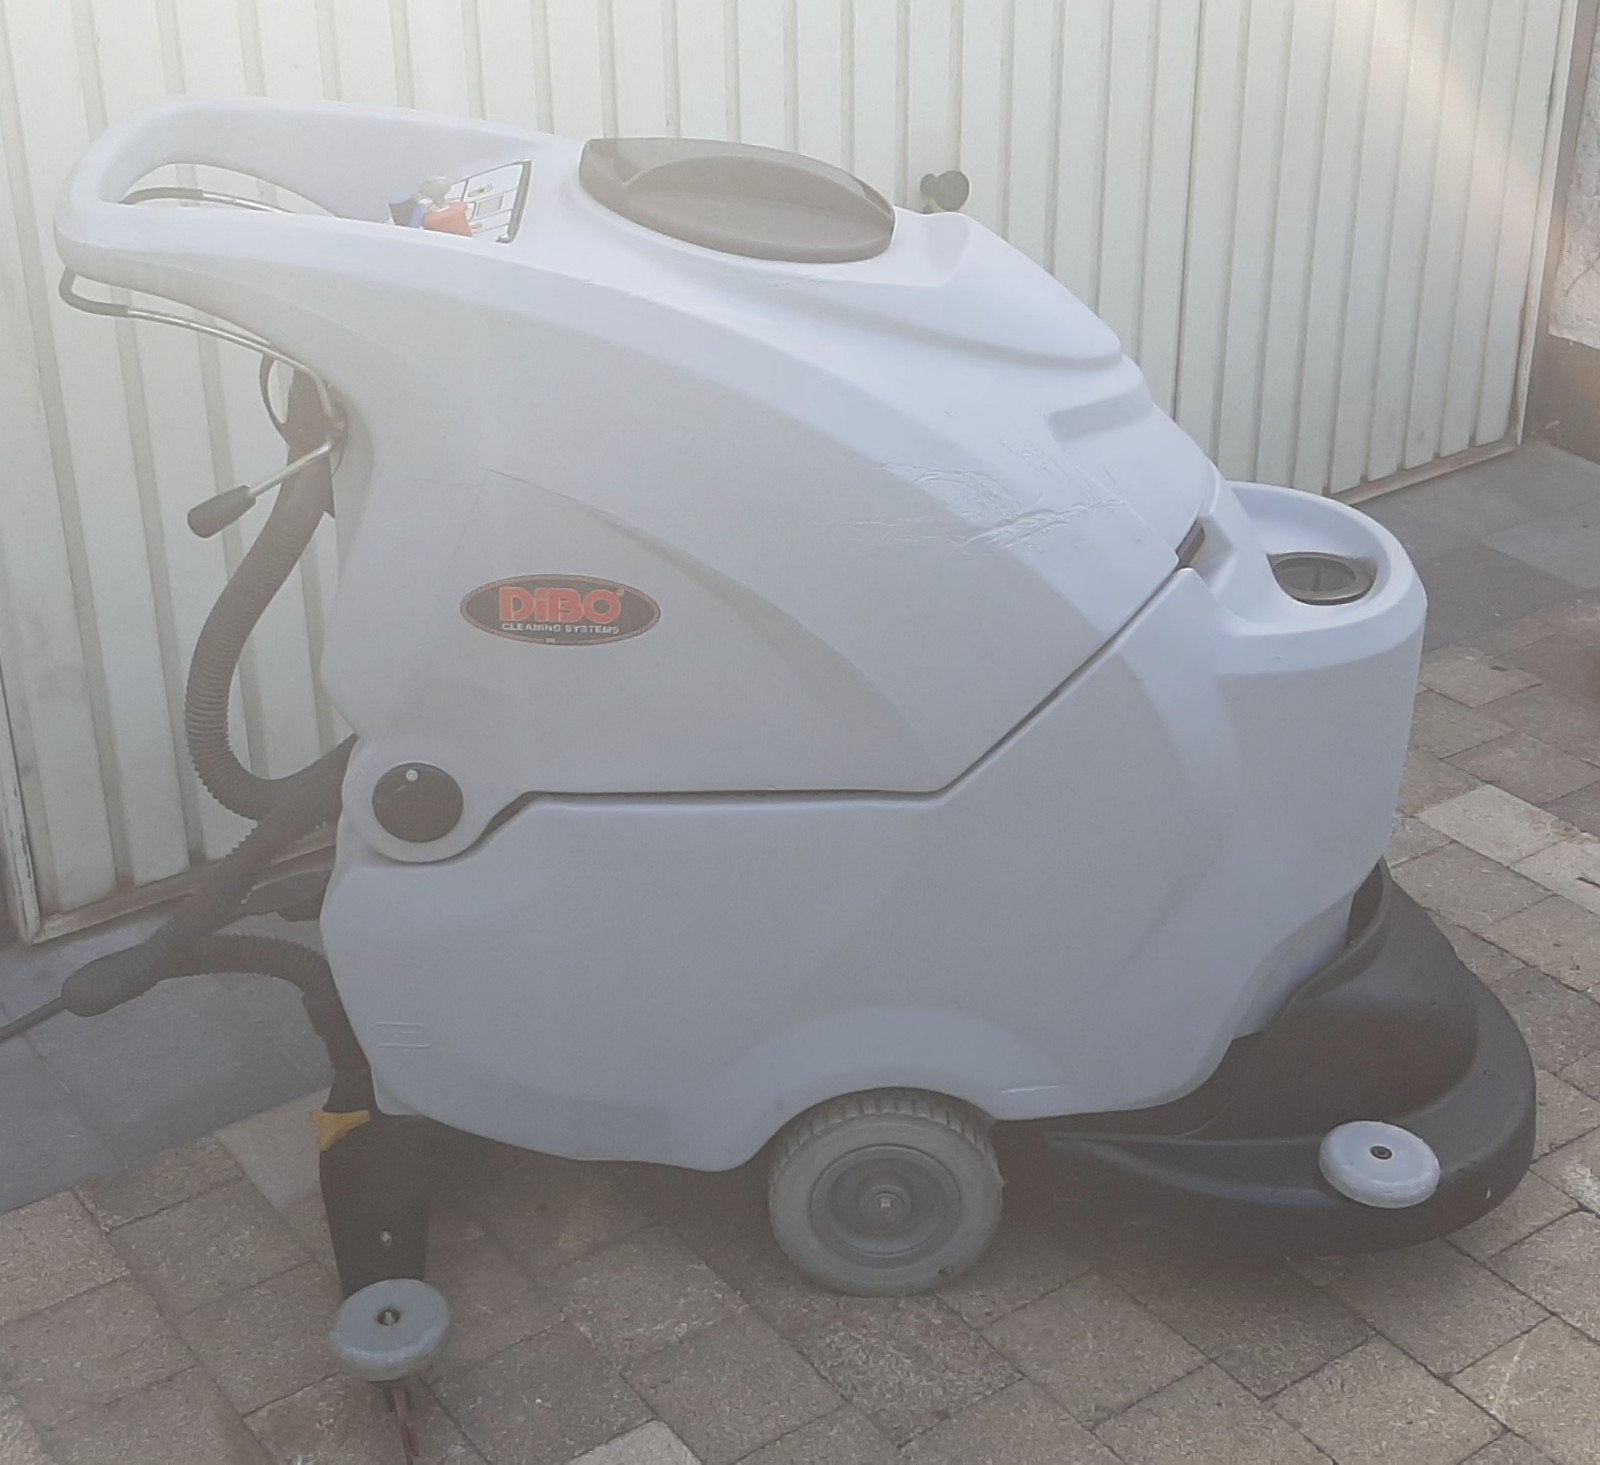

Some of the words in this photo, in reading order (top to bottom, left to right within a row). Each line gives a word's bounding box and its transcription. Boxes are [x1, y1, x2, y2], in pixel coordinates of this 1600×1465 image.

[499, 586, 622, 625] DiBO
[501, 623, 561, 633] CLEANING
[565, 624, 620, 635] SYSTEMS
